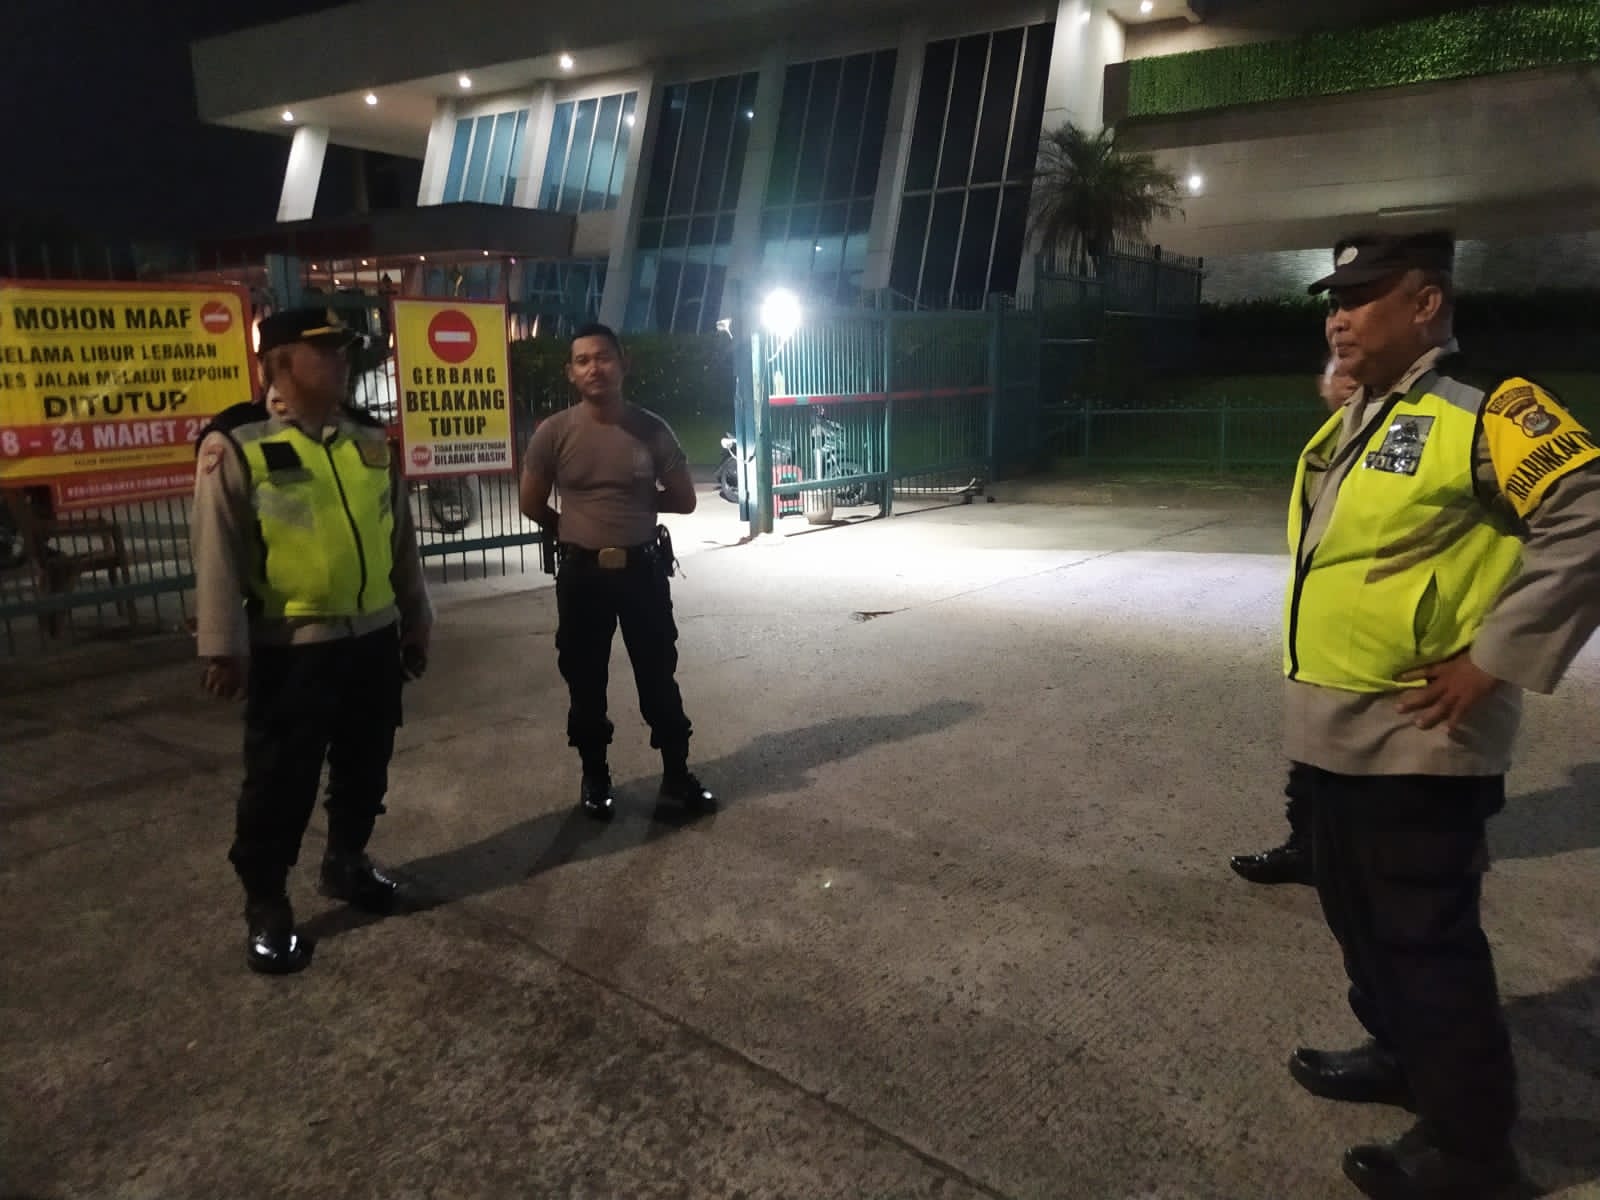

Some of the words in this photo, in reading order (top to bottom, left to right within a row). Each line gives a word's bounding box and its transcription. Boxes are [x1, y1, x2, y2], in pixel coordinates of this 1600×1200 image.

[14, 307, 115, 330] MOHON
[124, 307, 192, 330] MAAF
[0, 344, 74, 365] ELAMA
[81, 344, 135, 364] LIBUR
[142, 342, 217, 361] LEBARAN
[34, 370, 90, 389] JALAN
[172, 365, 241, 384] BIZPOINT
[412, 367, 497, 385] GERBANG
[43, 389, 188, 420] DITUTUP
[406, 390, 505, 413] BELAKANG
[50, 426, 85, 454] 24
[92, 420, 178, 450] MARET
[428, 415, 487, 437] TUTUP
[434, 452, 476, 466] DILARANG
[477, 451, 507, 465] MASUK
